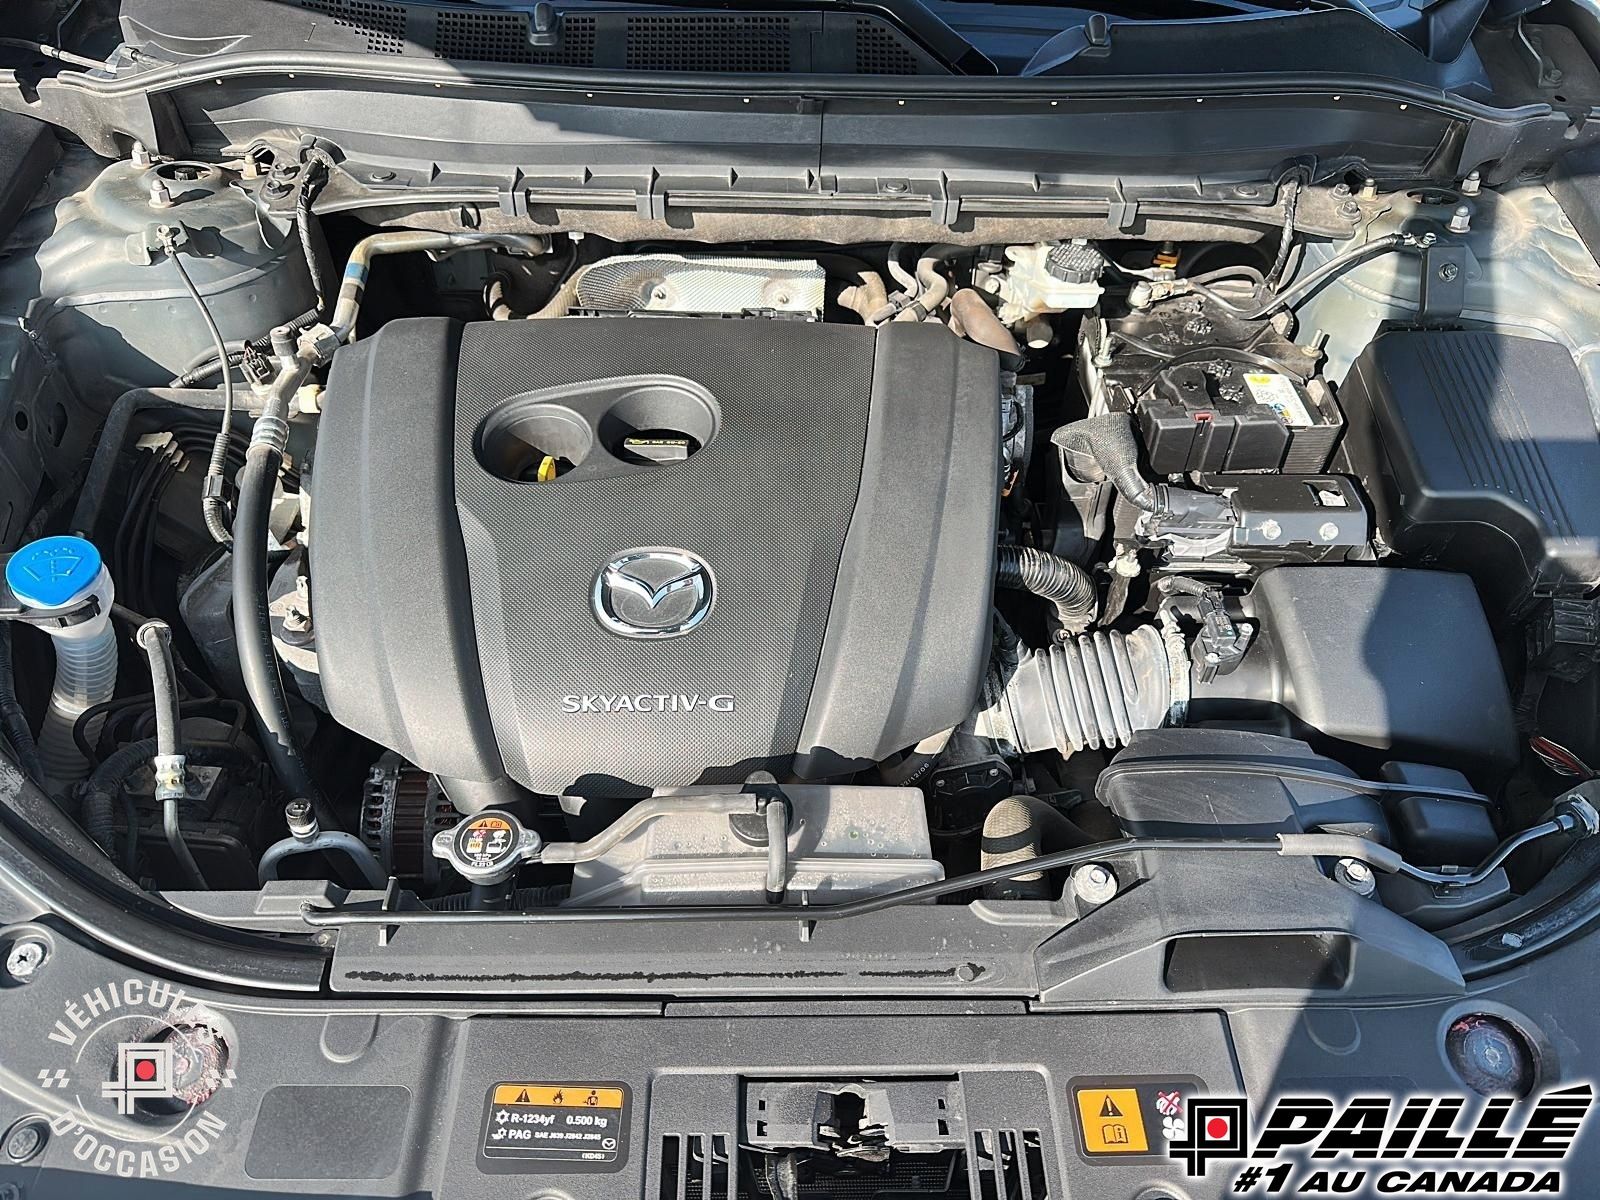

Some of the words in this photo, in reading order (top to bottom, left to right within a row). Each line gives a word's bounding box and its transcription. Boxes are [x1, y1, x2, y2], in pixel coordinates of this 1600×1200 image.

[561, 694, 735, 713] SKYACTIV-G
[510, 1113, 556, 1126] R-1234yf
[566, 1115, 593, 1125] 0.500
[594, 1116, 608, 1128] kg
[508, 1129, 532, 1140] PAG
